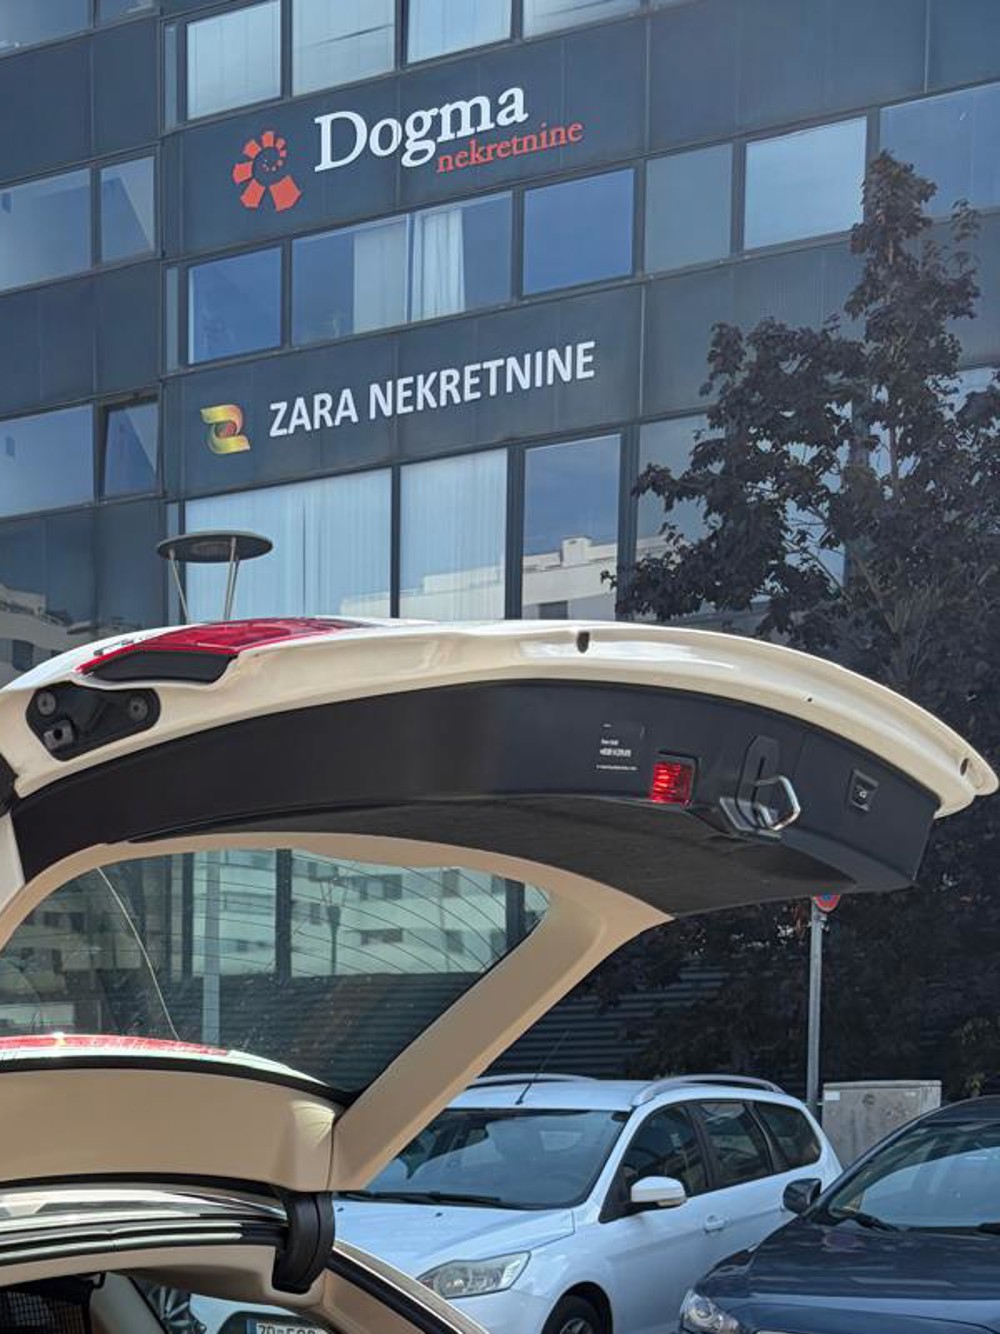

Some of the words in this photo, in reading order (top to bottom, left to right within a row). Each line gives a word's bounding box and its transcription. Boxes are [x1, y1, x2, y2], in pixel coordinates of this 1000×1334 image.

[313, 86, 530, 172] Dogma
[436, 121, 584, 172] nekretnine
[269, 388, 359, 438] ZARA
[369, 341, 596, 420] NEKRETNINE
